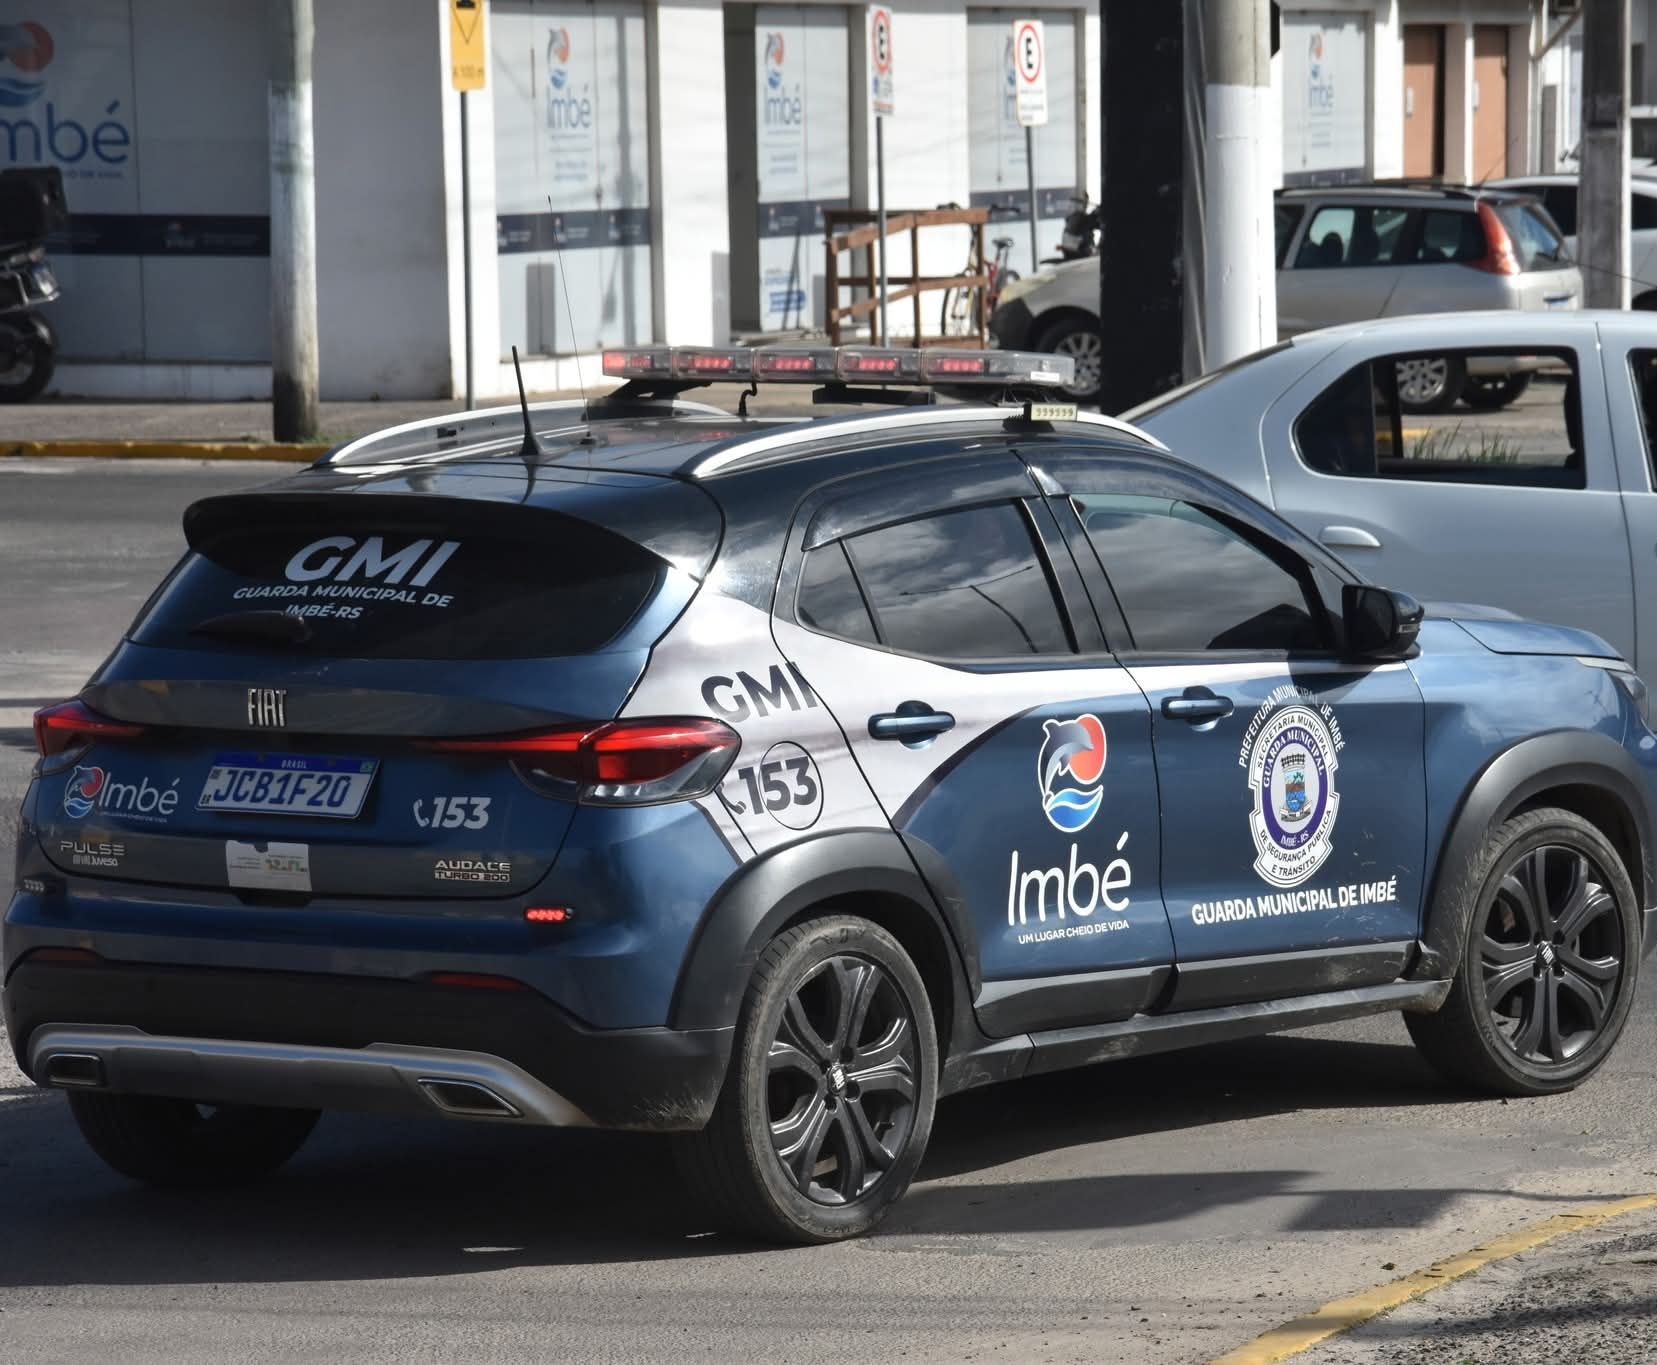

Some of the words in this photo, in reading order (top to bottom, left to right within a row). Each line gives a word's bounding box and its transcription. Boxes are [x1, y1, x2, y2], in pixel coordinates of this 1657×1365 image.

[546, 84, 592, 129] Imbé
[0, 100, 130, 164] mbé
[285, 536, 462, 587] GMI
[233, 585, 310, 600] GUARDA
[311, 585, 417, 604] MUNICIPAL
[421, 592, 454, 608] DE
[284, 603, 363, 619] IMBÉ-RS
[247, 688, 287, 727] FIAT
[700, 660, 818, 723] GMI
[1238, 695, 1276, 768] PREFEITURA
[1328, 716, 1346, 752] IMBÉ
[1257, 715, 1295, 768] SECRETARIA
[1297, 715, 1329, 757] MUNICIPAL
[280, 759, 308, 769] BRASIL
[1263, 735, 1287, 788] GUARDA
[1287, 729, 1323, 776] MUNICIPAL
[98, 772, 180, 815] Imbé
[213, 769, 352, 808] JCB1F20
[738, 756, 818, 815] 153
[431, 797, 492, 829] 153
[61, 840, 125, 856] PULSE
[435, 860, 511, 871] AUDACE
[1260, 829, 1269, 844] DE
[1267, 842, 1307, 863] SEGURANÇA
[436, 871, 480, 881] TURBO
[483, 873, 510, 882] 200
[1008, 831, 1131, 926] Imbé
[1271, 864, 1278, 874] E
[1191, 897, 1257, 925] GUARDA
[1256, 887, 1338, 917] MUNICIPAL
[1338, 884, 1358, 907] DE
[1359, 875, 1397, 905] IMBÉ
[1018, 934, 1034, 944] UM
[1034, 929, 1065, 942] LUGAR
[1066, 925, 1093, 937] CHEIO
[1094, 923, 1108, 933] DE
[1108, 920, 1130, 930] VIDA
